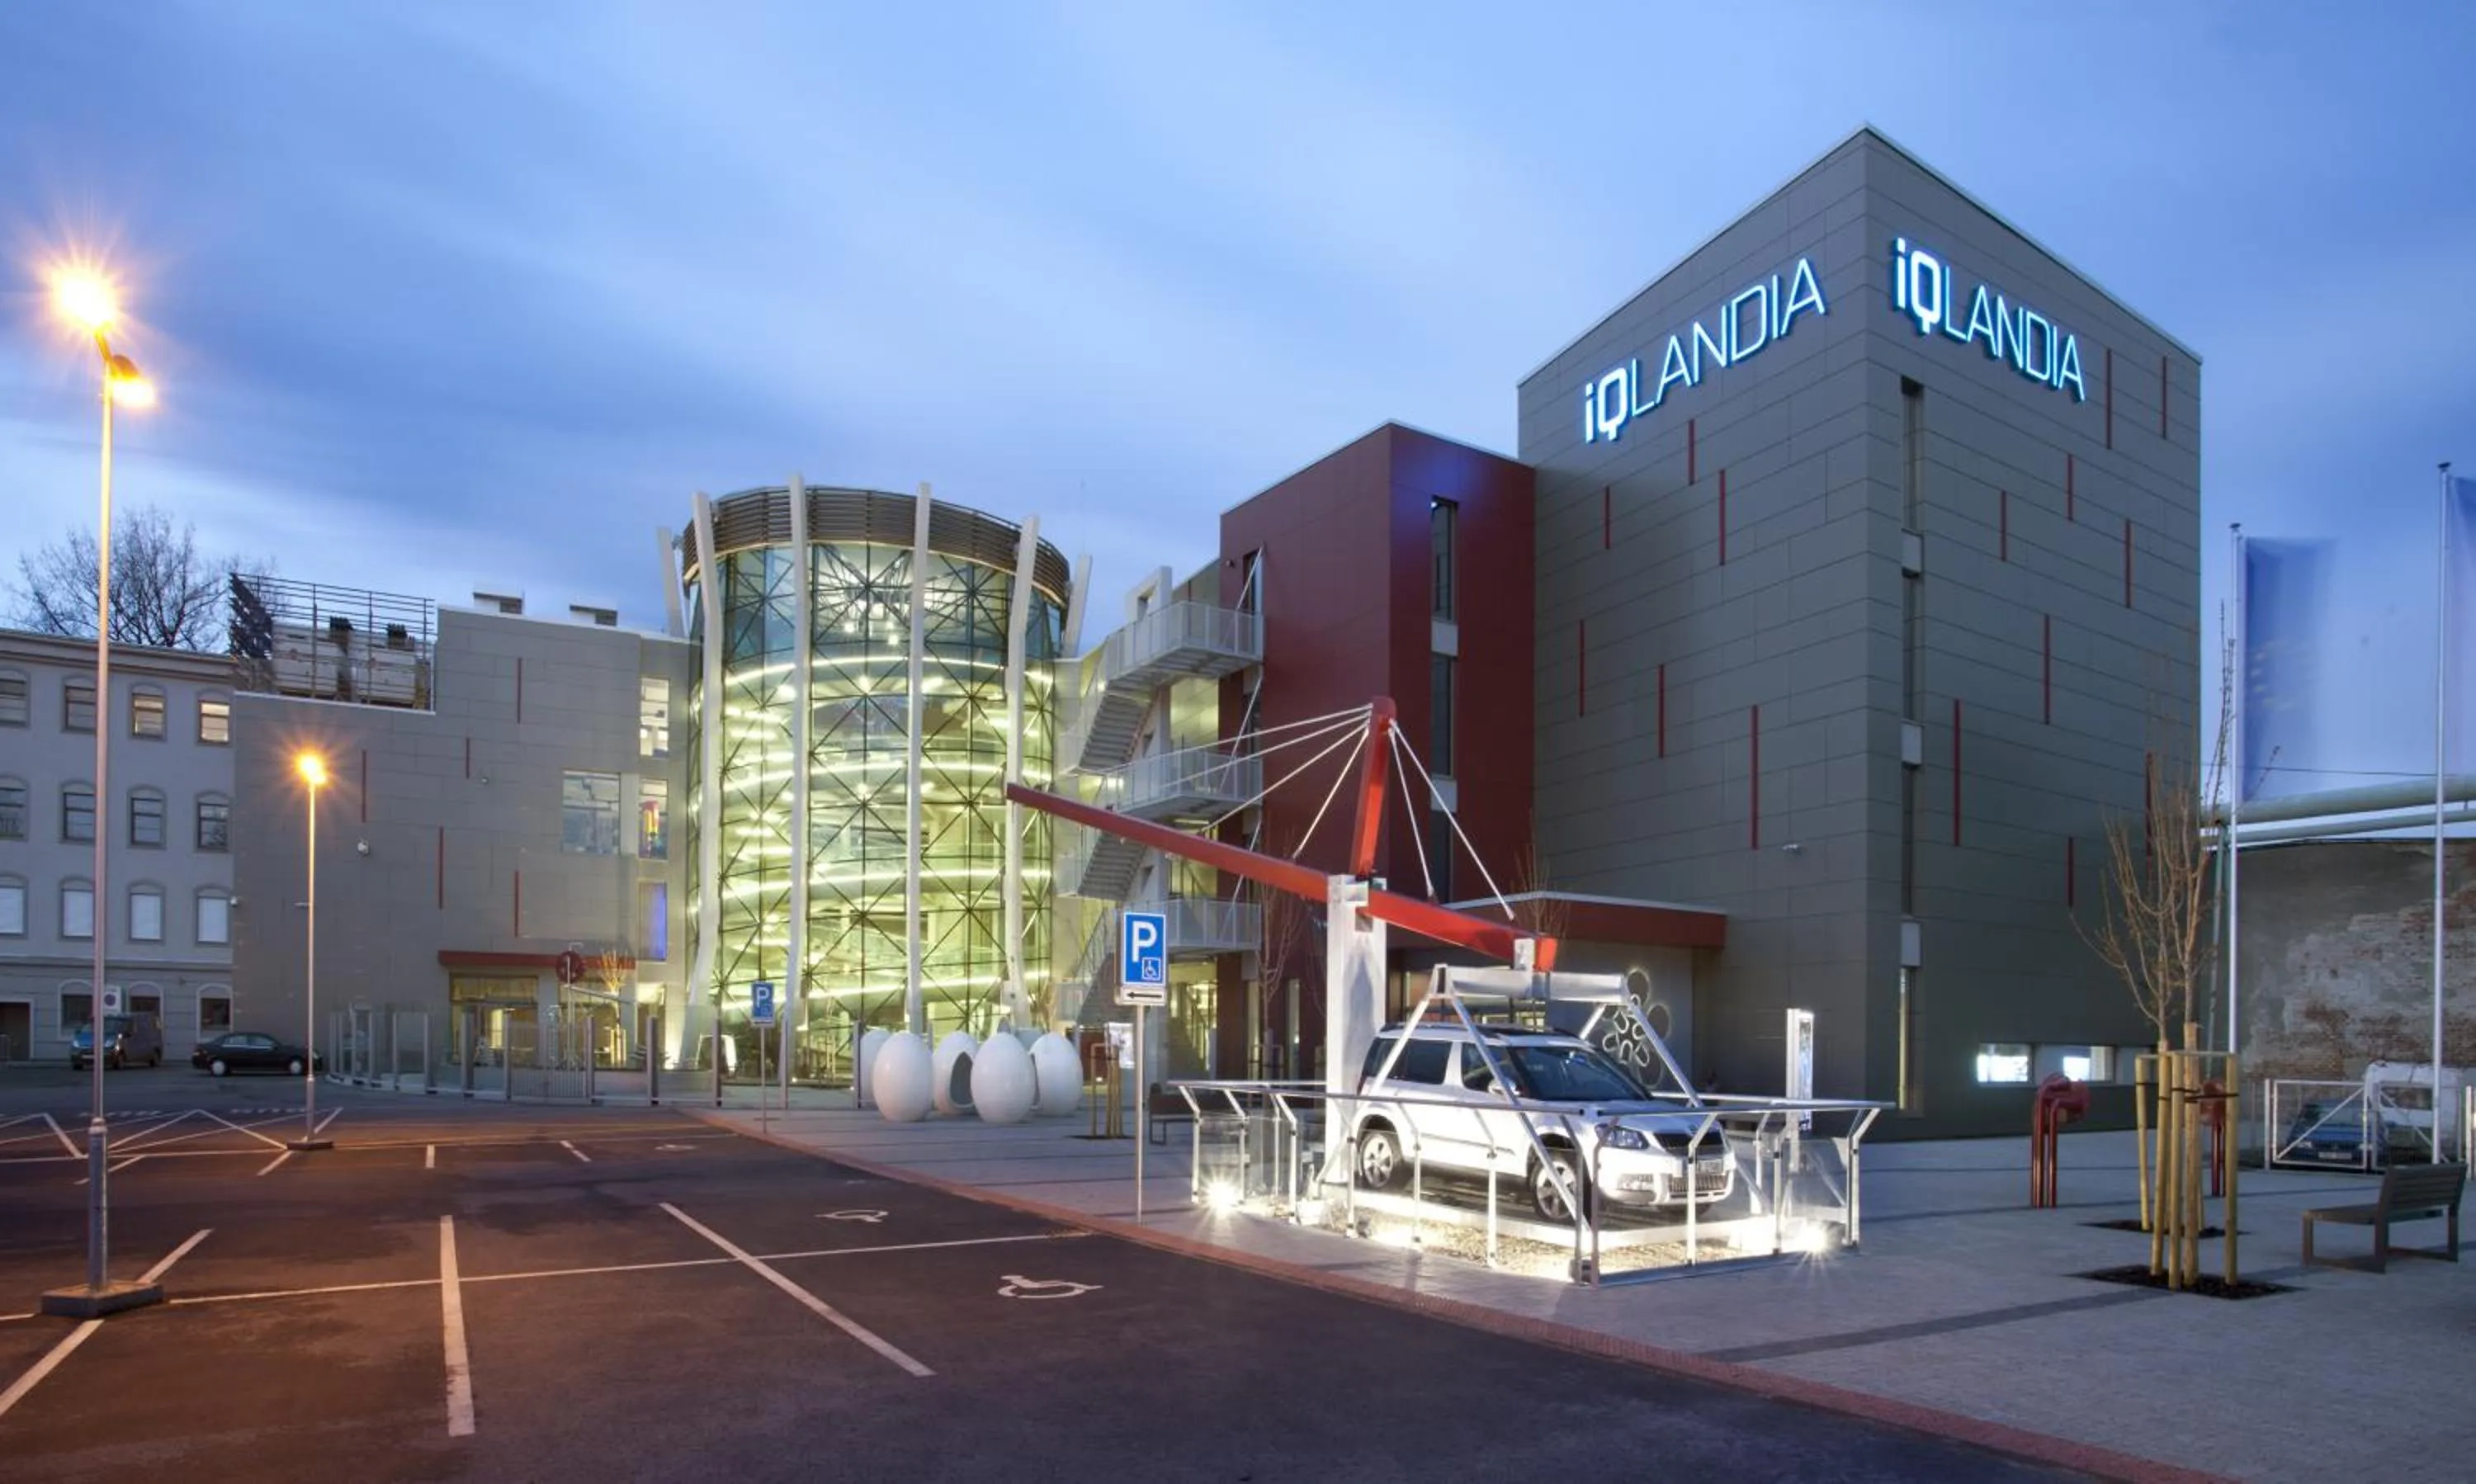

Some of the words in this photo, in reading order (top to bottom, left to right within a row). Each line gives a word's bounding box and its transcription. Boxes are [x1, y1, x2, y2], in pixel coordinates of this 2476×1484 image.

[1585, 258, 1826, 443] iQLANDIA
[1897, 237, 2086, 401] iQLANDIA
[1132, 920, 1157, 963] P
[756, 986, 769, 1008] P
